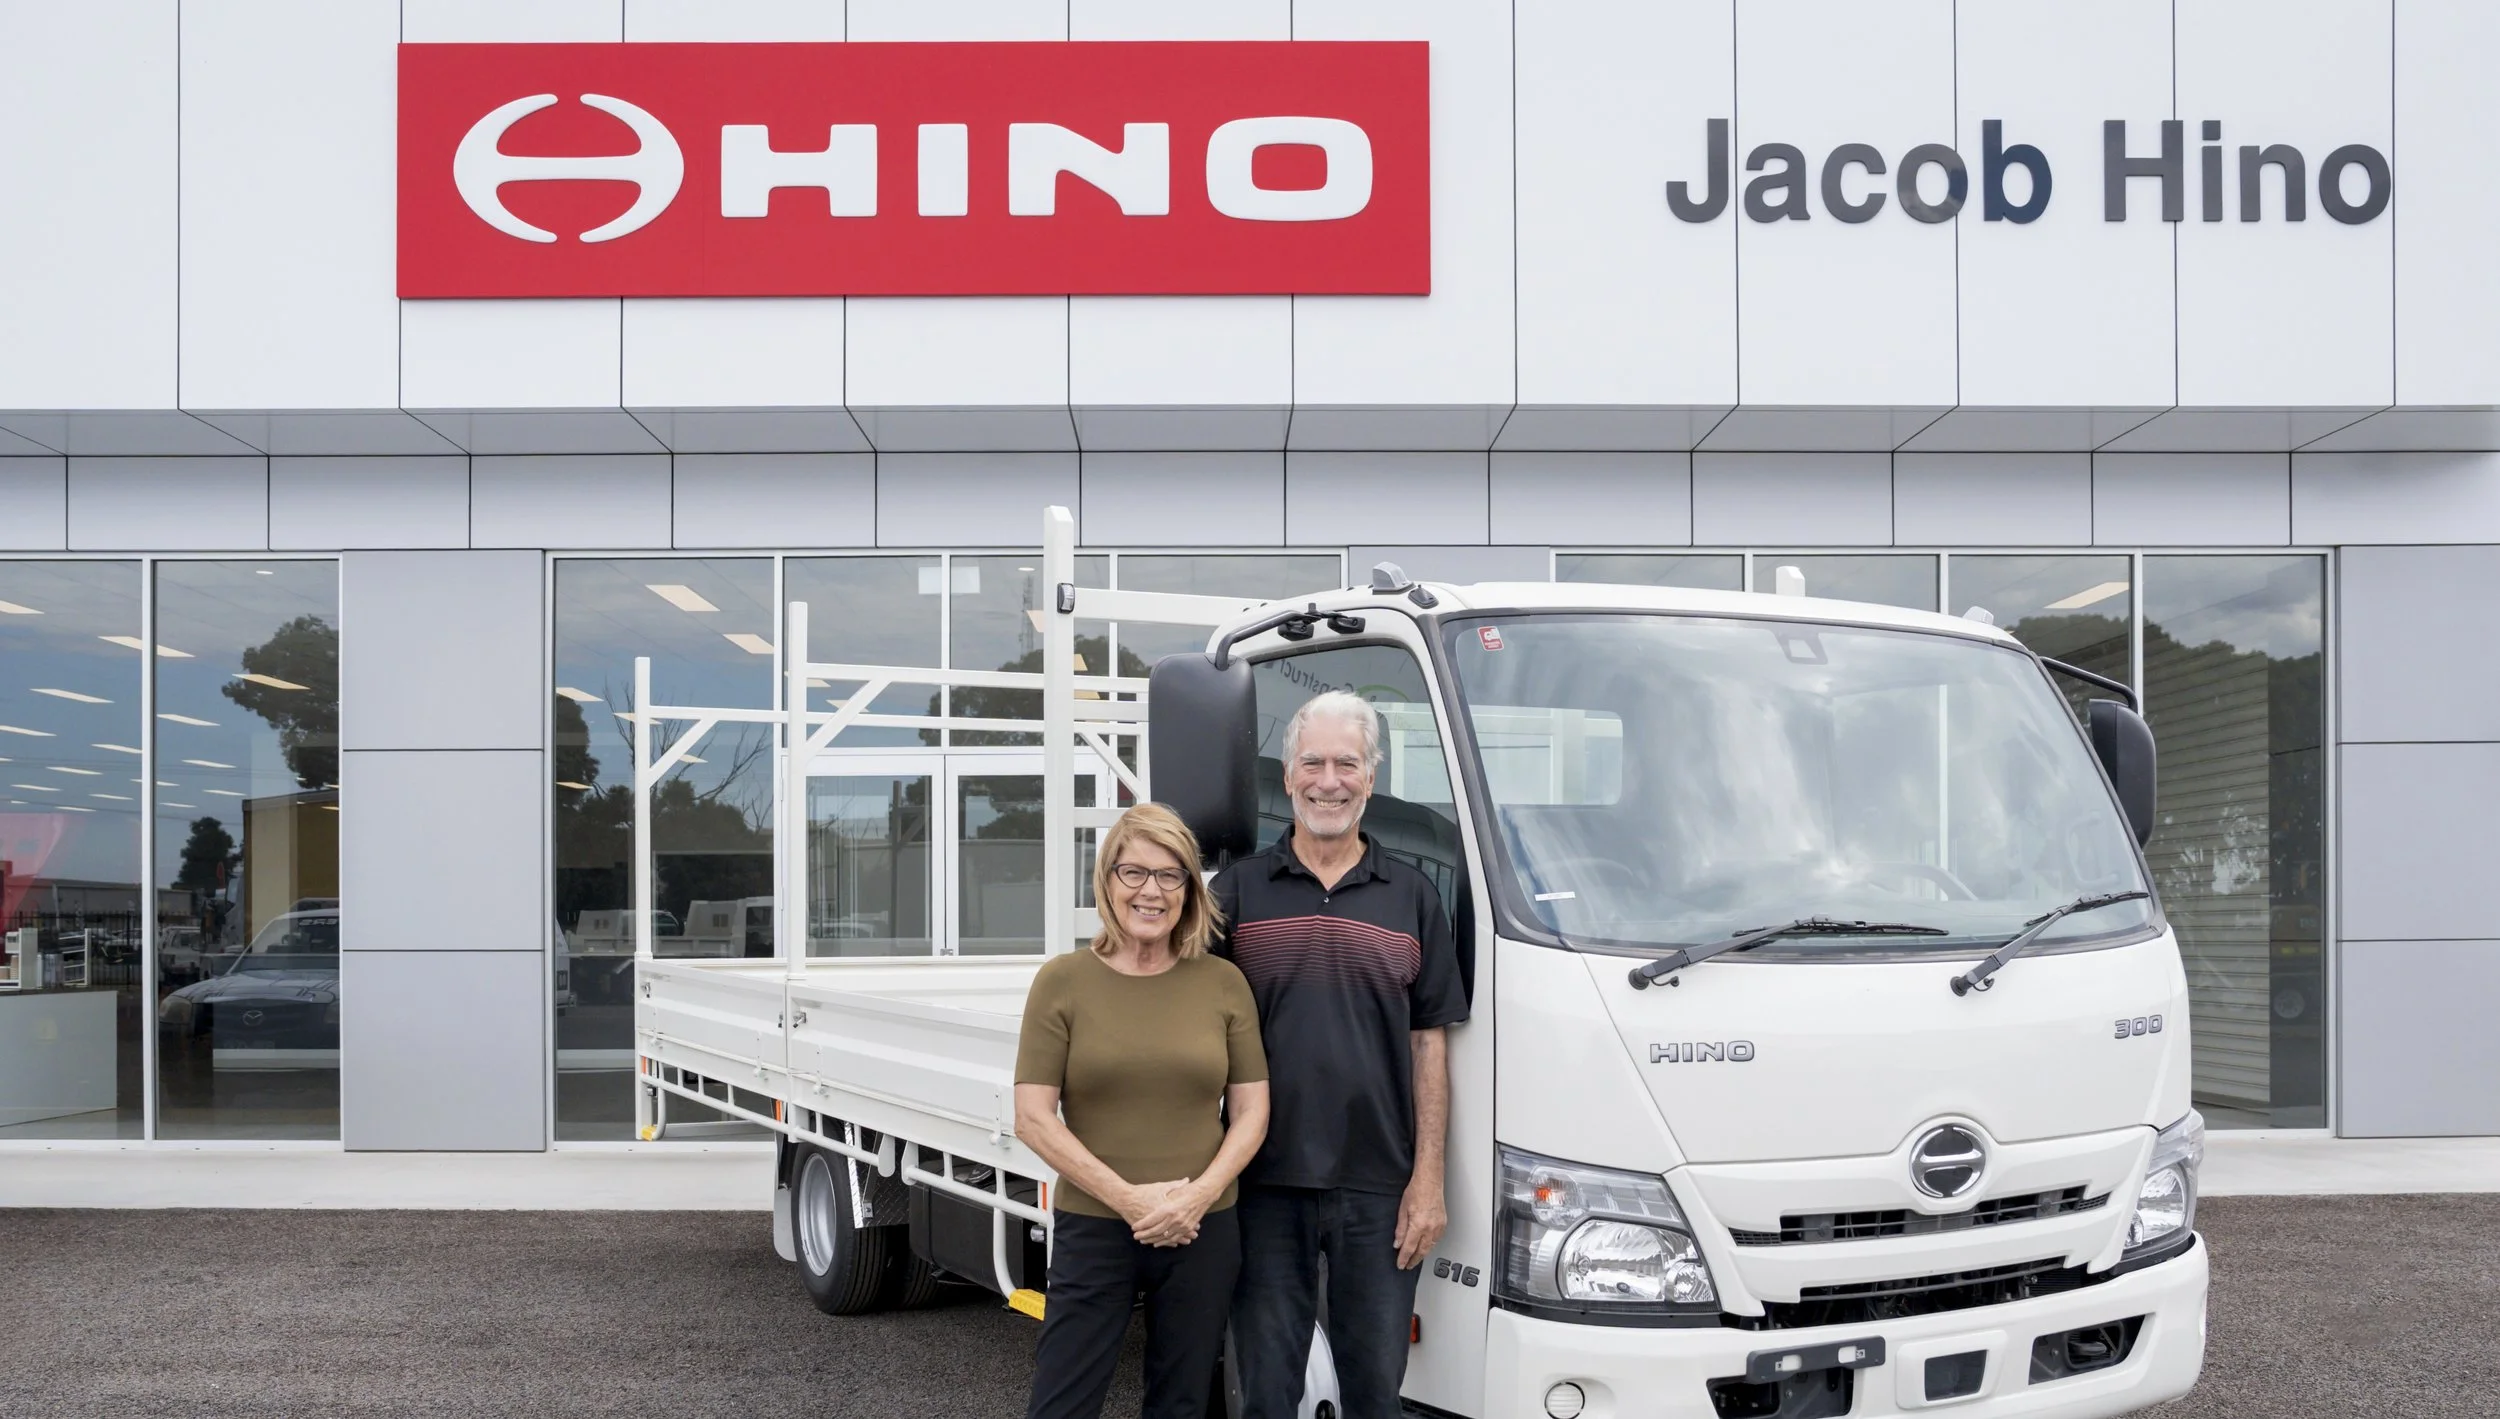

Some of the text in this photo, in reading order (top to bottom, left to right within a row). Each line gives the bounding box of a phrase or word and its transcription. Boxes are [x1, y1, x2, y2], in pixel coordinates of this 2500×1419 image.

[720, 115, 1374, 222] HINO
[1666, 117, 2392, 225] Jacob Hino
[2114, 1014, 2162, 1039] 300
[1650, 1040, 1755, 1063] HINO
[1433, 1257, 1480, 1287] 616
